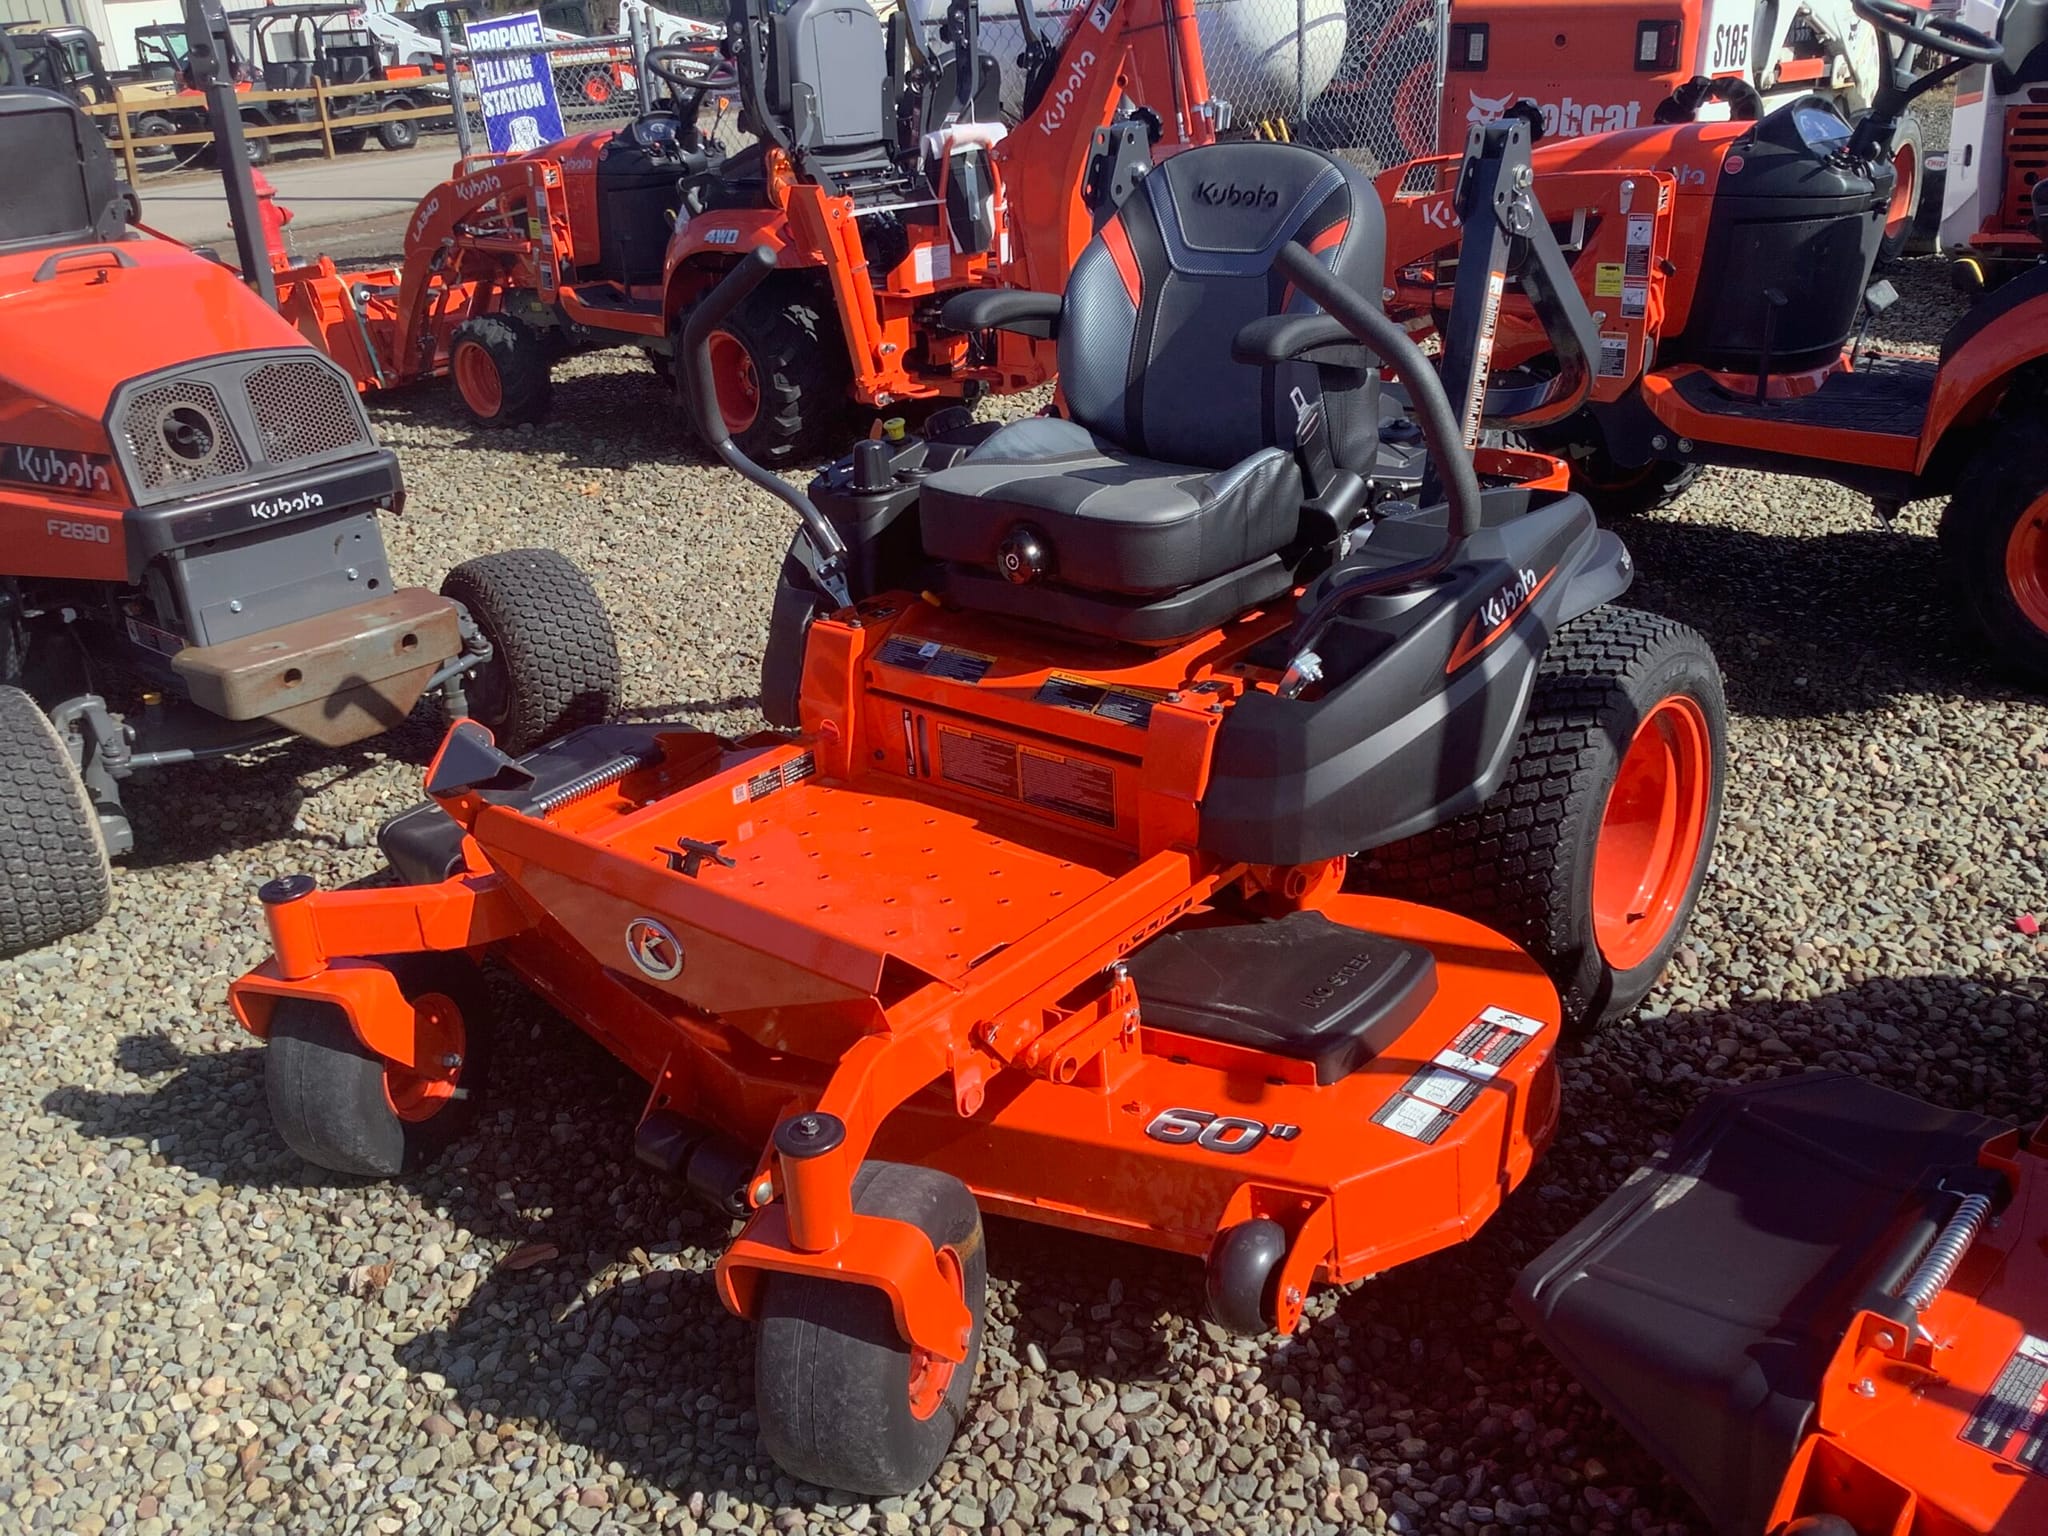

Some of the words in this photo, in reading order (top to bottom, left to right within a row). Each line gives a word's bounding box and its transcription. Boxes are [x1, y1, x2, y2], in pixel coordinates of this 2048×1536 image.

[469, 22, 541, 50] PROPANE
[1713, 24, 1749, 68] S185
[477, 58, 535, 88] FILLING
[482, 82, 546, 117] STATION
[1040, 50, 1096, 135] Kubota
[456, 174, 501, 200] Kubota
[1197, 181, 1279, 208] Kubota
[413, 198, 440, 242] LA340
[704, 229, 740, 244] 4WD
[16, 446, 111, 491] Kubota
[251, 491, 324, 519] Kubota
[47, 520, 110, 543] F2690
[1480, 568, 1538, 626] Kubota
[1145, 1107, 1302, 1154] 60"
